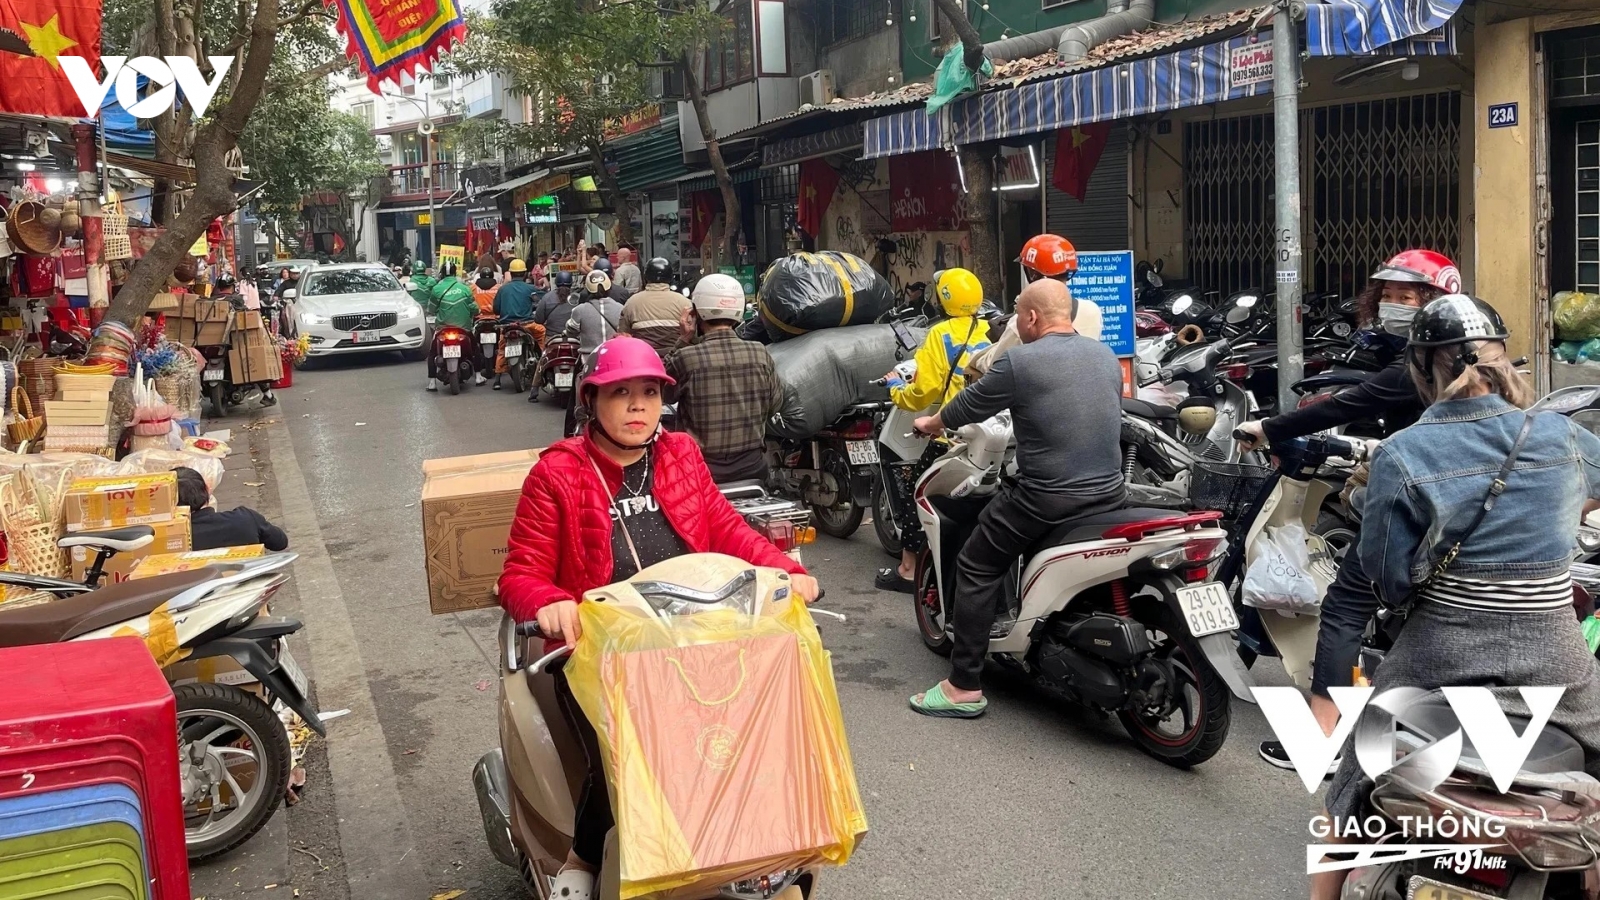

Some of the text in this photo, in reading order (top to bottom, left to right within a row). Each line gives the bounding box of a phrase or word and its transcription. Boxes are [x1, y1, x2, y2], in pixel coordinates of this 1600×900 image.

[1491, 107, 1515, 124] 23A
[1082, 547, 1132, 560] VISION
[1185, 586, 1223, 611] 29-C1
[1189, 606, 1236, 633] 819.43
